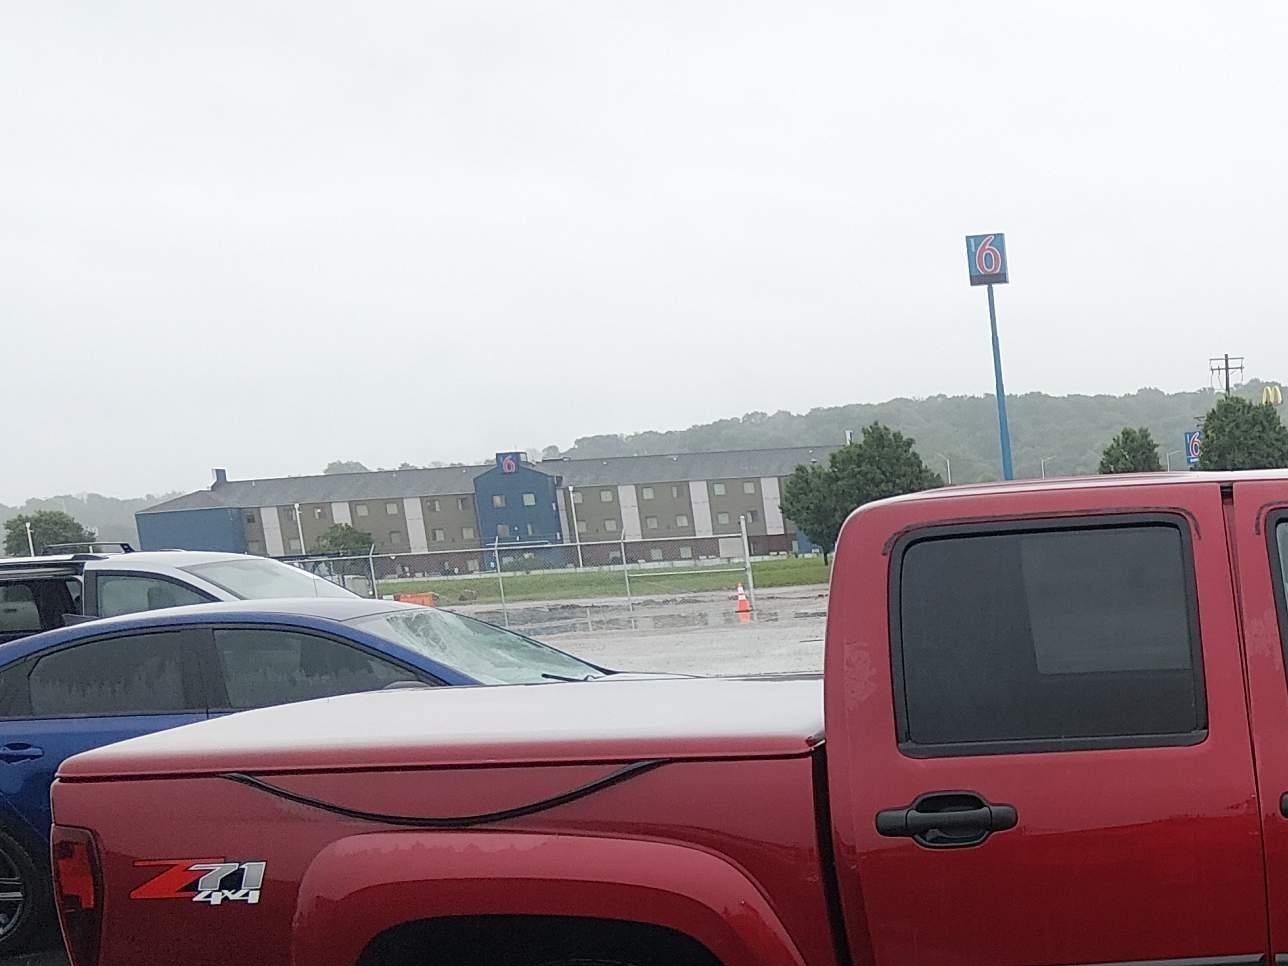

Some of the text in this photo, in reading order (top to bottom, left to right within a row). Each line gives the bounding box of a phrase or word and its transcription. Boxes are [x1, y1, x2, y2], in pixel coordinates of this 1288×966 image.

[976, 235, 1001, 275] 6
[1190, 432, 1201, 457] 6
[503, 455, 516, 473] 6
[130, 858, 266, 899] Z71
